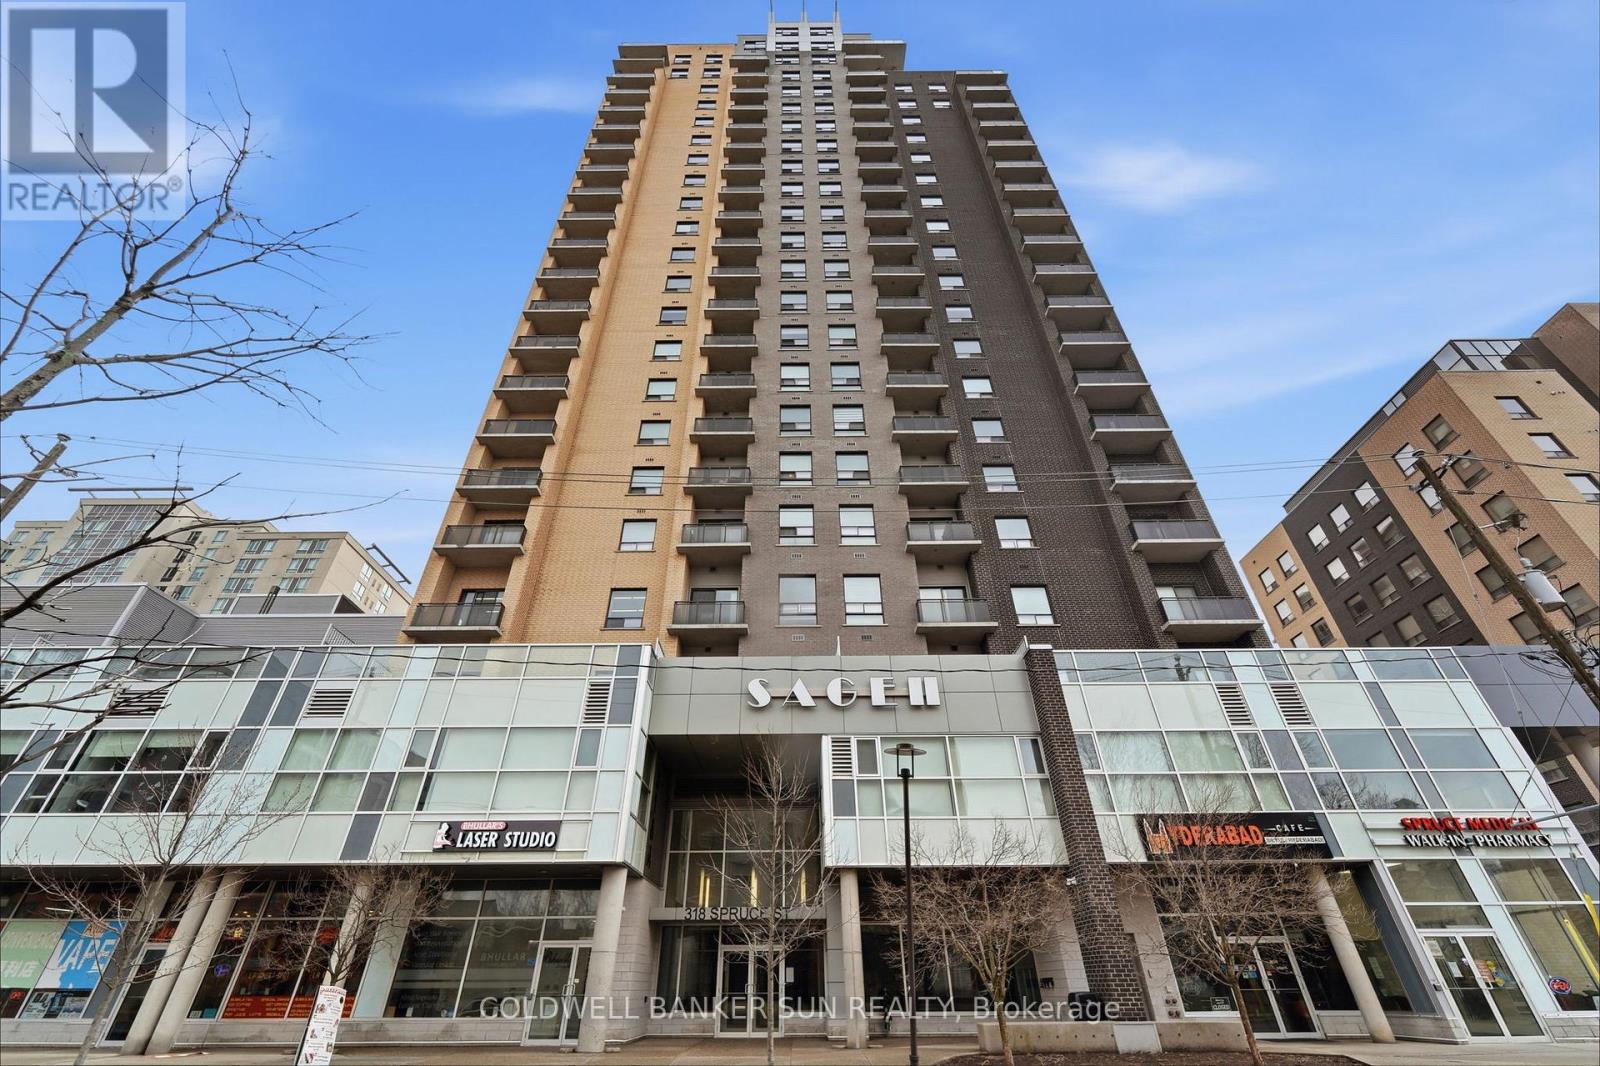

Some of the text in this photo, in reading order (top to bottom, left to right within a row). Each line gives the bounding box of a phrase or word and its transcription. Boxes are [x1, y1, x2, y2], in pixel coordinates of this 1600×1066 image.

[1275, 823, 1305, 832] CAFE
[1400, 816, 1466, 831] SPRUCE
[455, 831, 556, 848] LASER STUDIO
[1404, 834, 1553, 847] WALK-IN PHARMACY
[684, 907, 706, 920] 318
[57, 938, 117, 972] VAPE
